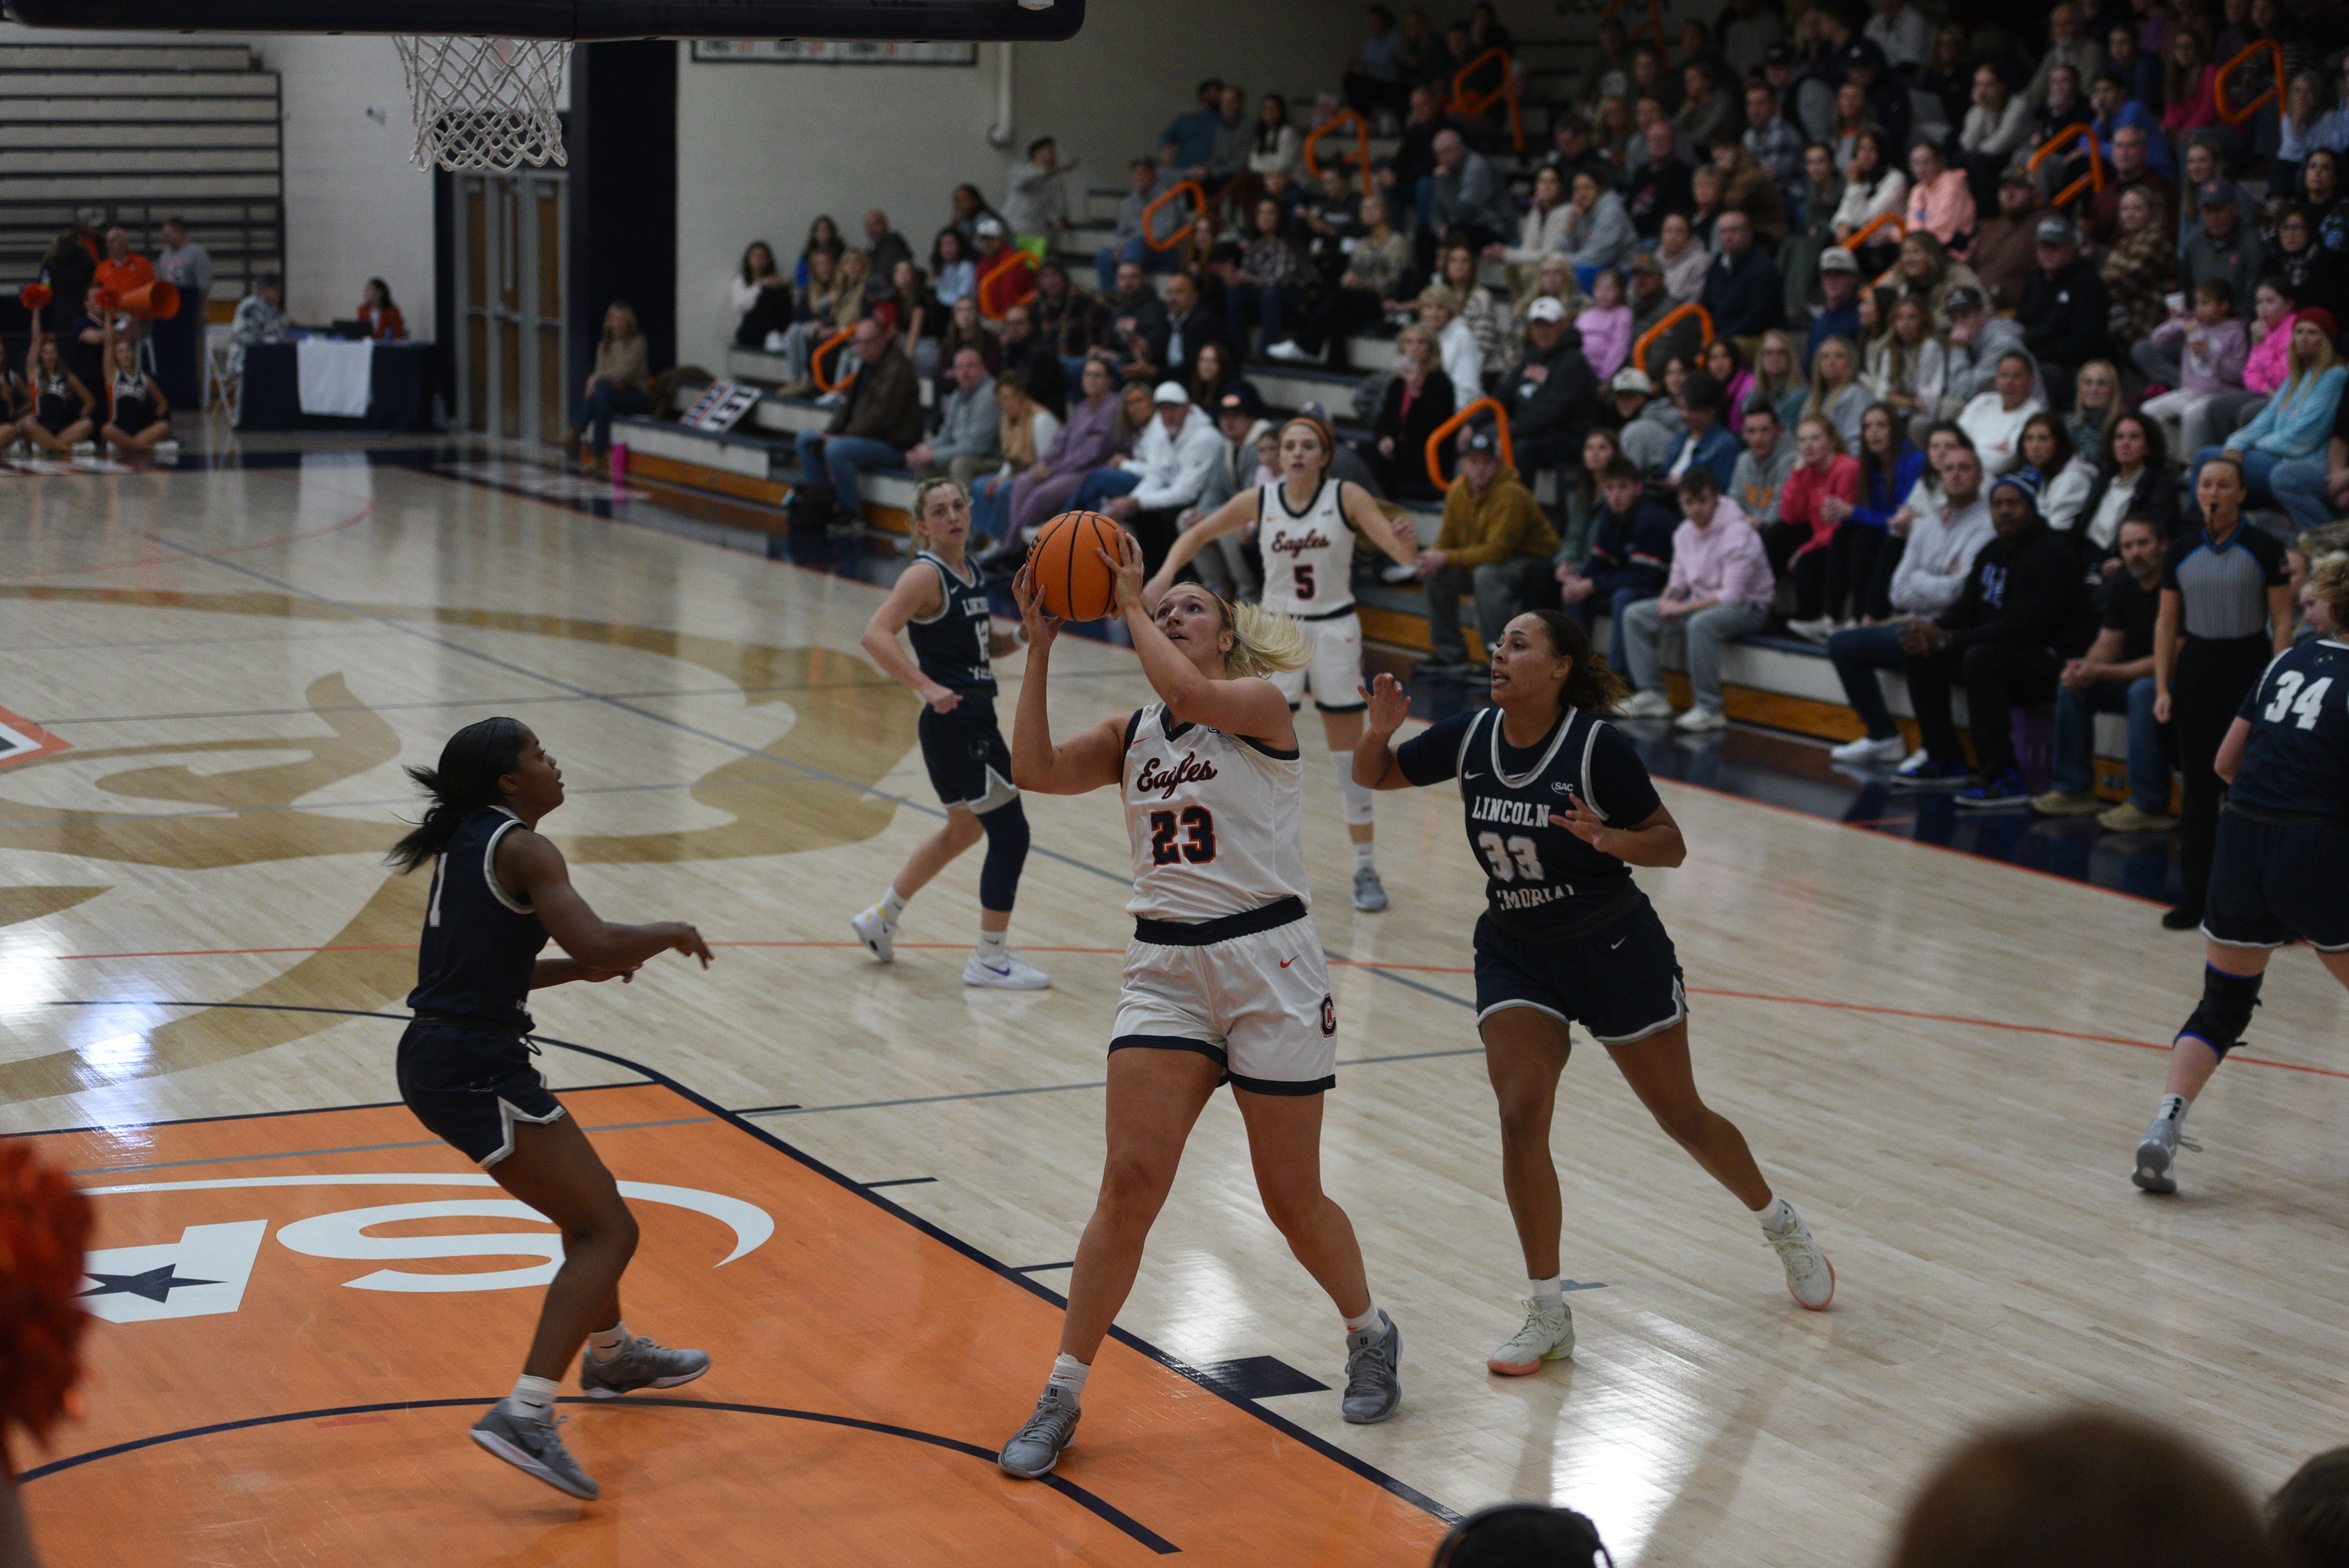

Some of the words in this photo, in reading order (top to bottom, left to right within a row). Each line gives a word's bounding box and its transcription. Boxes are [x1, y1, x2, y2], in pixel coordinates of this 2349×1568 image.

[1270, 528, 1330, 558] Eagles
[1293, 564, 1315, 602] 5
[2264, 669, 2334, 732] 34
[1137, 751, 1218, 800] Eagles
[1554, 781, 1575, 792] SAC
[1471, 795, 1551, 828] LINCOLN
[1150, 805, 1217, 867] 23
[1478, 830, 1545, 883] 33
